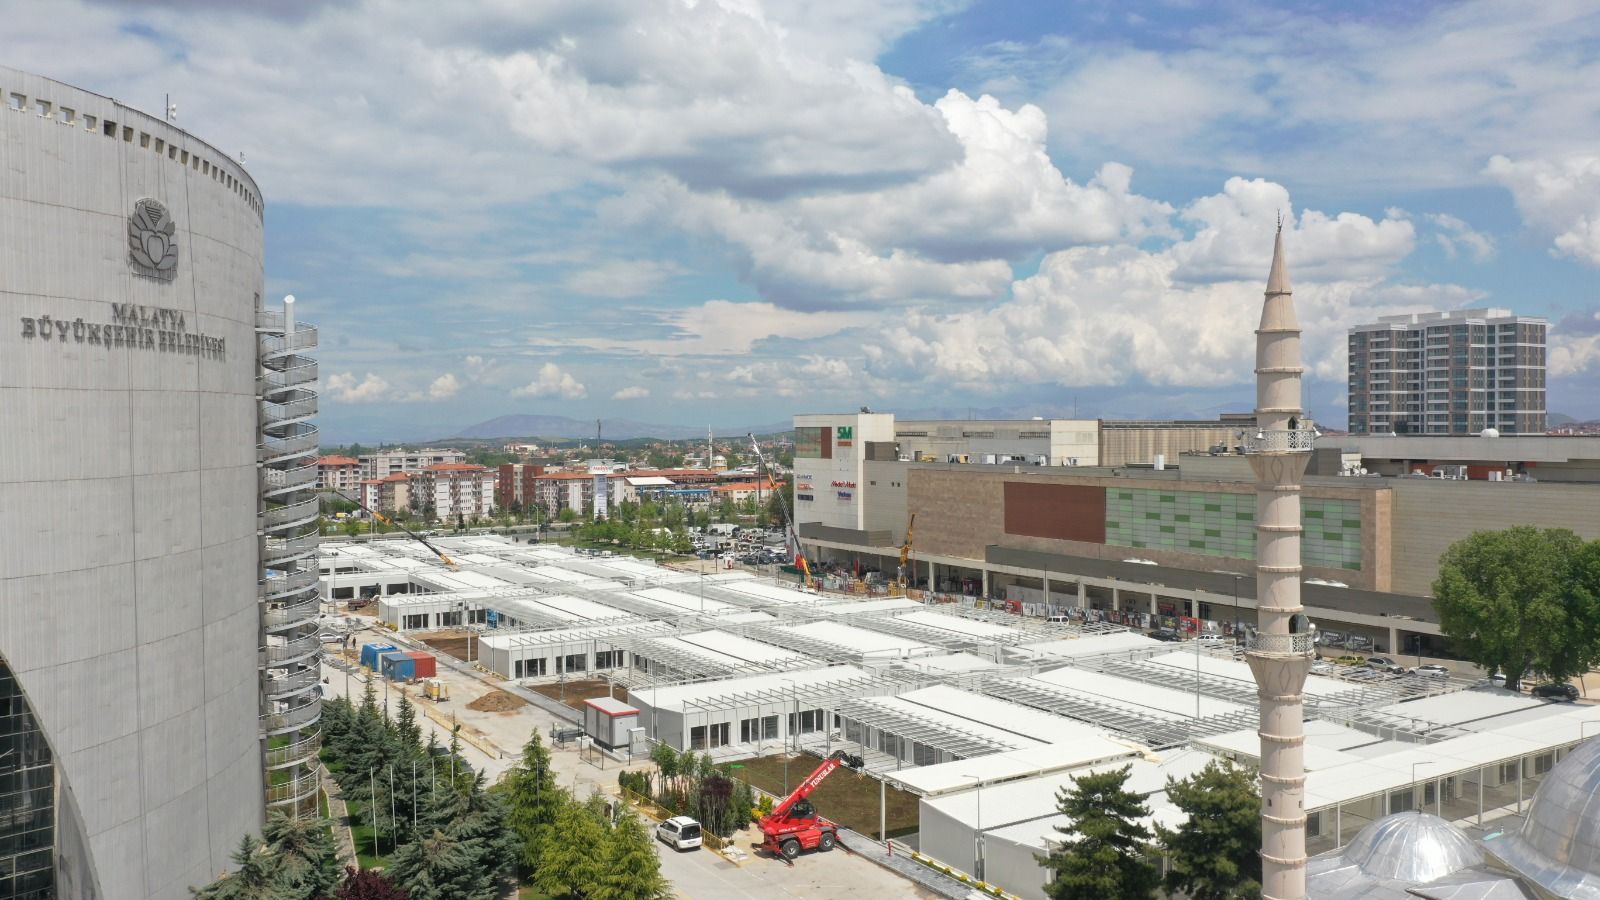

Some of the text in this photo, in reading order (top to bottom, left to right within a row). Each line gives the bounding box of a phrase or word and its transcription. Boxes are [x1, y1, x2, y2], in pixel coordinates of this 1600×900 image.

[112, 303, 186, 329] MALATYA
[21, 315, 155, 349] BÜYÜKŞEHİR
[810, 763, 836, 787] YUNUSLAR
